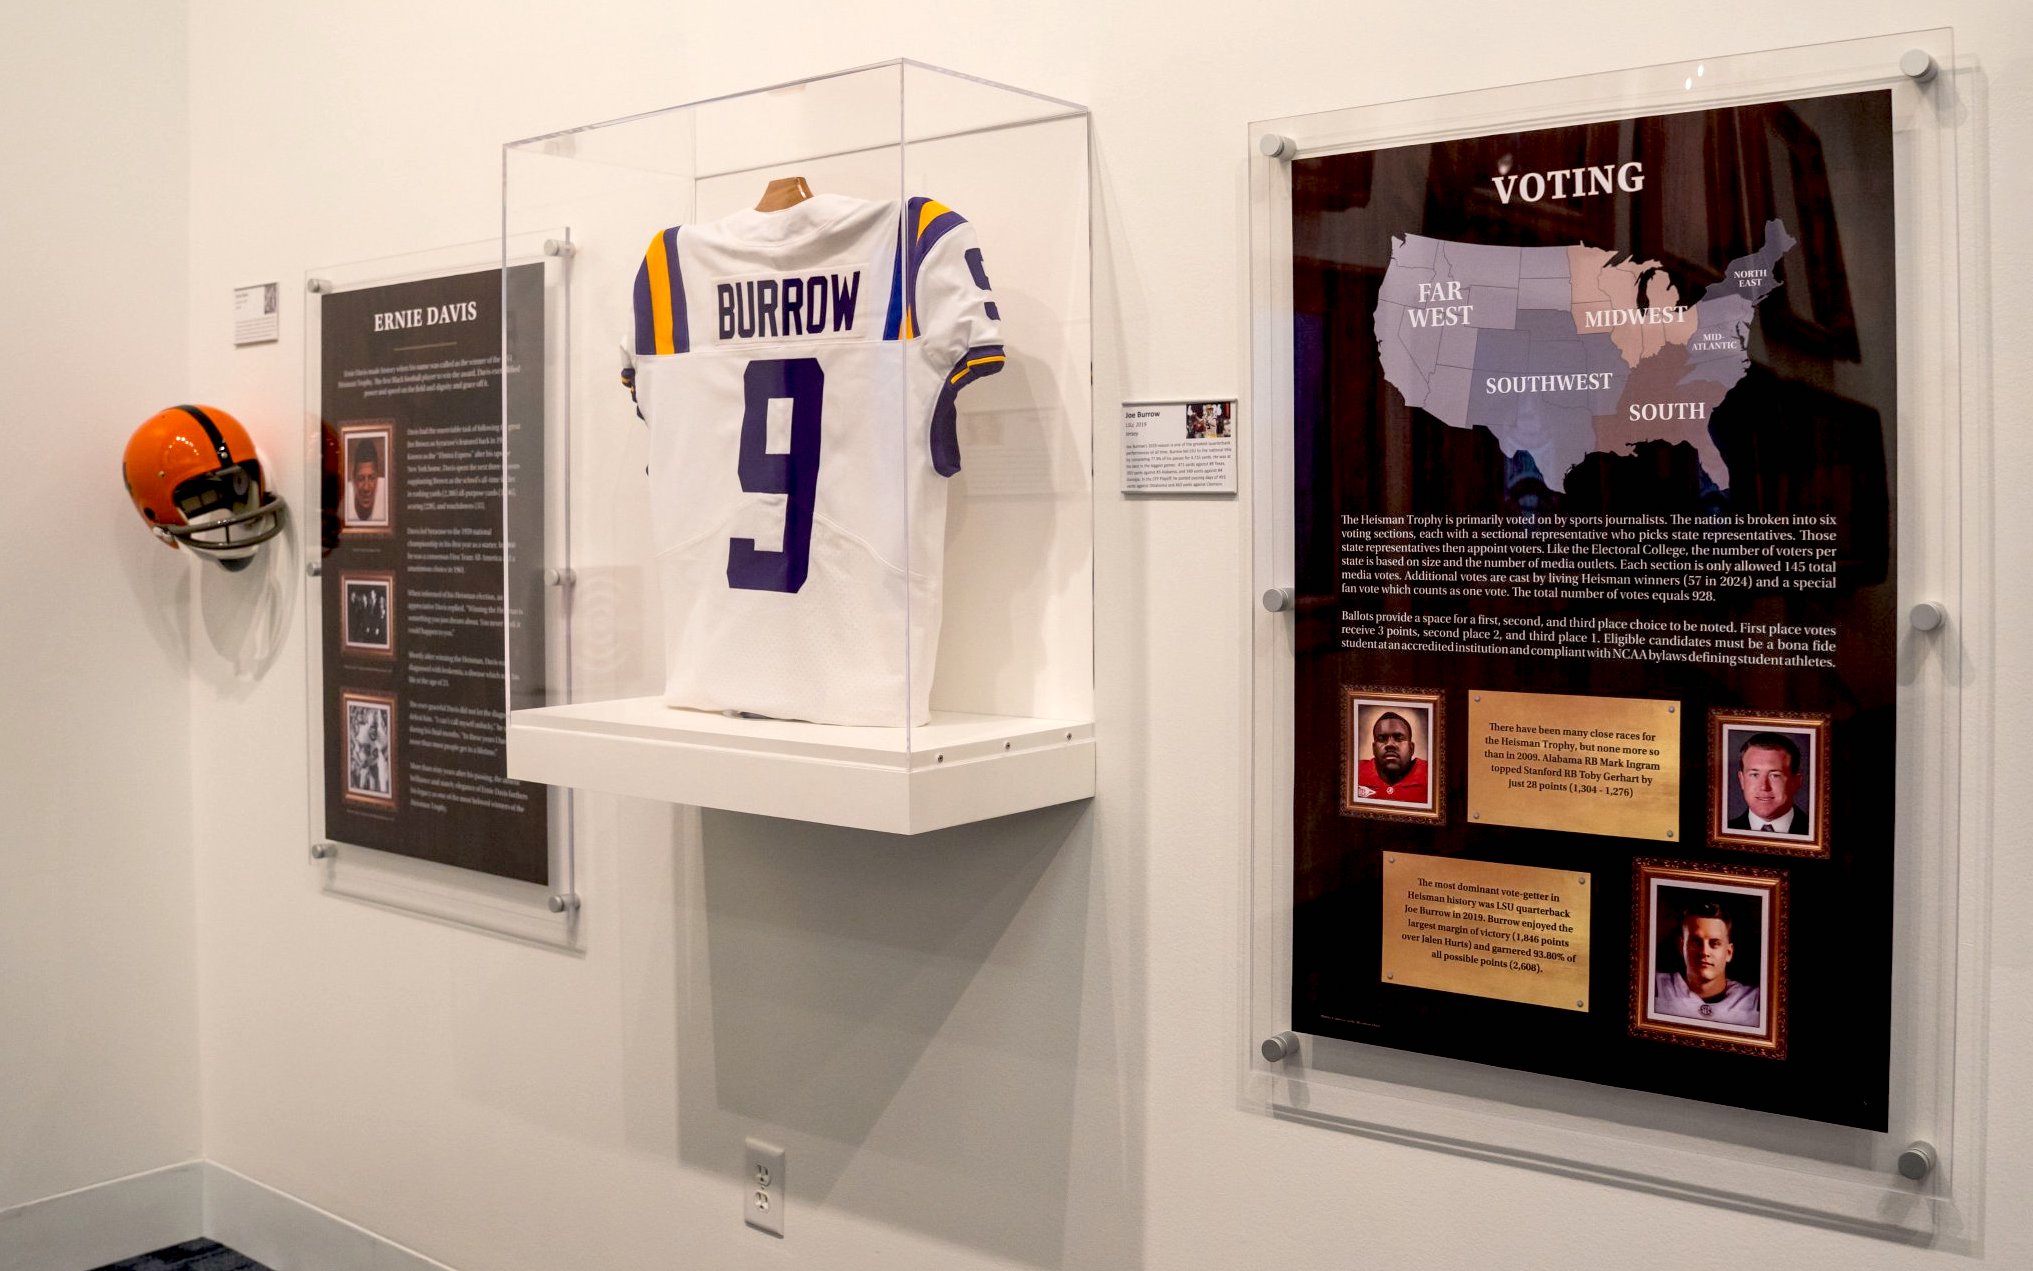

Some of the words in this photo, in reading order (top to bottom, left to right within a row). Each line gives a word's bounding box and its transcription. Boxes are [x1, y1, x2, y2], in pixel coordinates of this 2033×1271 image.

[1492, 162, 1645, 204] VOTING
[1734, 269, 1767, 279] NORTH
[1739, 279, 1762, 288] EAST
[1418, 281, 1462, 303] FAR
[374, 308, 423, 332] ERNIE
[427, 301, 478, 326] DAVIS
[717, 271, 860, 340] BURROW
[1408, 305, 1474, 328] WEST
[1585, 305, 1688, 328] MIDWEST
[1692, 341, 1737, 351] ATLANTIC
[1703, 333, 1725, 341] MID-
[1486, 372, 1613, 395] SOUTHWEST
[1629, 402, 1706, 421] SOUTH
[727, 357, 825, 594] 9
[1340, 514, 1358, 524] The
[1361, 514, 1404, 524] Heisman
[1406, 514, 1443, 527] Trophy
[1445, 514, 1453, 524] is
[1456, 514, 1503, 527] primarily
[1506, 513, 1535, 524] voted
[1537, 516, 1552, 524] on
[1554, 514, 1567, 527] by
[1569, 516, 1602, 527] sports
[1604, 514, 1667, 527] journalists.
[1670, 513, 1691, 524] The
[1694, 514, 1732, 524] nation
[1734, 514, 1744, 524] is
[1747, 513, 1789, 525] broken
[1792, 514, 1817, 525] into
[1819, 514, 1836, 524] six
[1341, 528, 1371, 541] voting
[1373, 528, 1416, 539] sections,
[1419, 528, 1443, 538] each
[1446, 528, 1468, 538] with
[1481, 528, 1528, 539] sectional
[1531, 528, 1608, 542] representative
[1611, 528, 1635, 539] who
[1639, 528, 1668, 542] picks
[1672, 530, 1699, 540] state
[1703, 529, 1795, 543] representatives.
[1799, 529, 1836, 540] Those
[1342, 569, 1371, 579] media
[1374, 572, 1401, 580] votes.
[1404, 570, 1457, 581] Additional
[1460, 573, 1487, 581] votes
[1490, 574, 1506, 582] are
[1509, 574, 1530, 582] cast
[1533, 572, 1546, 585] by
[1548, 572, 1579, 586] living
[1581, 573, 1630, 584] Heisman
[1634, 575, 1680, 585] winners
[1683, 574, 1702, 587] (57
[1705, 575, 1716, 586] in
[1756, 576, 1779, 587] and
[1782, 579, 1790, 587] a
[1793, 577, 1836, 591] special
[1342, 610, 1374, 621] Ballots
[1376, 612, 1412, 624] provide
[1422, 615, 1451, 625] space
[1453, 613, 1468, 623] for
[1470, 616, 1476, 624] a
[1478, 614, 1500, 626] first,
[1503, 615, 1543, 630] second,
[1546, 616, 1567, 627] and
[1569, 617, 1595, 628] third
[1598, 617, 1628, 631] place
[1629, 618, 1667, 630] choice
[1669, 621, 1681, 631] to
[1683, 620, 1697, 631] be
[1700, 621, 1737, 632] noted.
[1740, 622, 1766, 633] First
[1768, 622, 1801, 637] place
[1804, 626, 1836, 635] votes
[1488, 722, 1514, 732] There
[1515, 724, 1536, 733] have
[1538, 725, 1560, 735] been
[1562, 729, 1588, 739] many
[1590, 728, 1614, 738] close
[1615, 732, 1640, 740] races
[1642, 731, 1656, 741] for
[1485, 735, 1499, 744] the
[1501, 737, 1541, 747] Heisman
[1541, 739, 1577, 752] Trophy,
[1579, 742, 1595, 751] but
[1596, 745, 1620, 753] none
[1622, 747, 1647, 755] more
[1648, 748, 1660, 756] so
[1484, 749, 1504, 758] than
[1506, 750, 1515, 759] in
[1516, 752, 1540, 761] 2009.
[1542, 753, 1582, 764] Alabama
[1584, 756, 1598, 765] RB
[1600, 757, 1624, 767] Mark
[1626, 759, 1660, 771] Ingram
[1491, 764, 1522, 775] topped
[1523, 765, 1562, 777] Stanford
[1564, 769, 1577, 778] RB
[1578, 770, 1602, 782] Toby
[1603, 771, 1639, 783] Gerhart
[1641, 774, 1653, 786] by
[1507, 778, 1524, 788] just
[1526, 780, 1537, 788] 28
[1538, 781, 1567, 791] points
[1417, 877, 1432, 887] The
[1434, 881, 1455, 889] most
[1457, 882, 1499, 895] dominant
[1501, 889, 1549, 901] vote-getter
[1550, 893, 1560, 902] in
[1407, 890, 1445, 902] Heisman
[1446, 895, 1476, 908] history
[1496, 901, 1514, 911] LSU
[1516, 905, 1571, 918] quarterback
[1404, 904, 1418, 913] Joe
[1420, 906, 1451, 917] Burrow
[1452, 910, 1461, 919] in
[1462, 911, 1485, 922] 2019.
[1487, 914, 1520, 926] Burrow
[1521, 919, 1557, 931] enjoyed
[1558, 923, 1573, 933] the
[1408, 918, 1436, 930] largest
[1437, 924, 1468, 935] margin
[1470, 927, 1479, 935] of
[1480, 928, 1510, 942] victory
[1540, 937, 1569, 947] points
[1401, 933, 1420, 941] over
[1421, 934, 1442, 945] Jalen
[1444, 937, 1472, 950] Hurts)
[1473, 942, 1490, 951] and
[1491, 945, 1532, 957] garnered
[1533, 949, 1565, 961] 93.80%
[1566, 954, 1576, 962] of
[1431, 949, 1442, 958] all
[1443, 953, 1478, 963] possible
[1480, 958, 1508, 968] points
